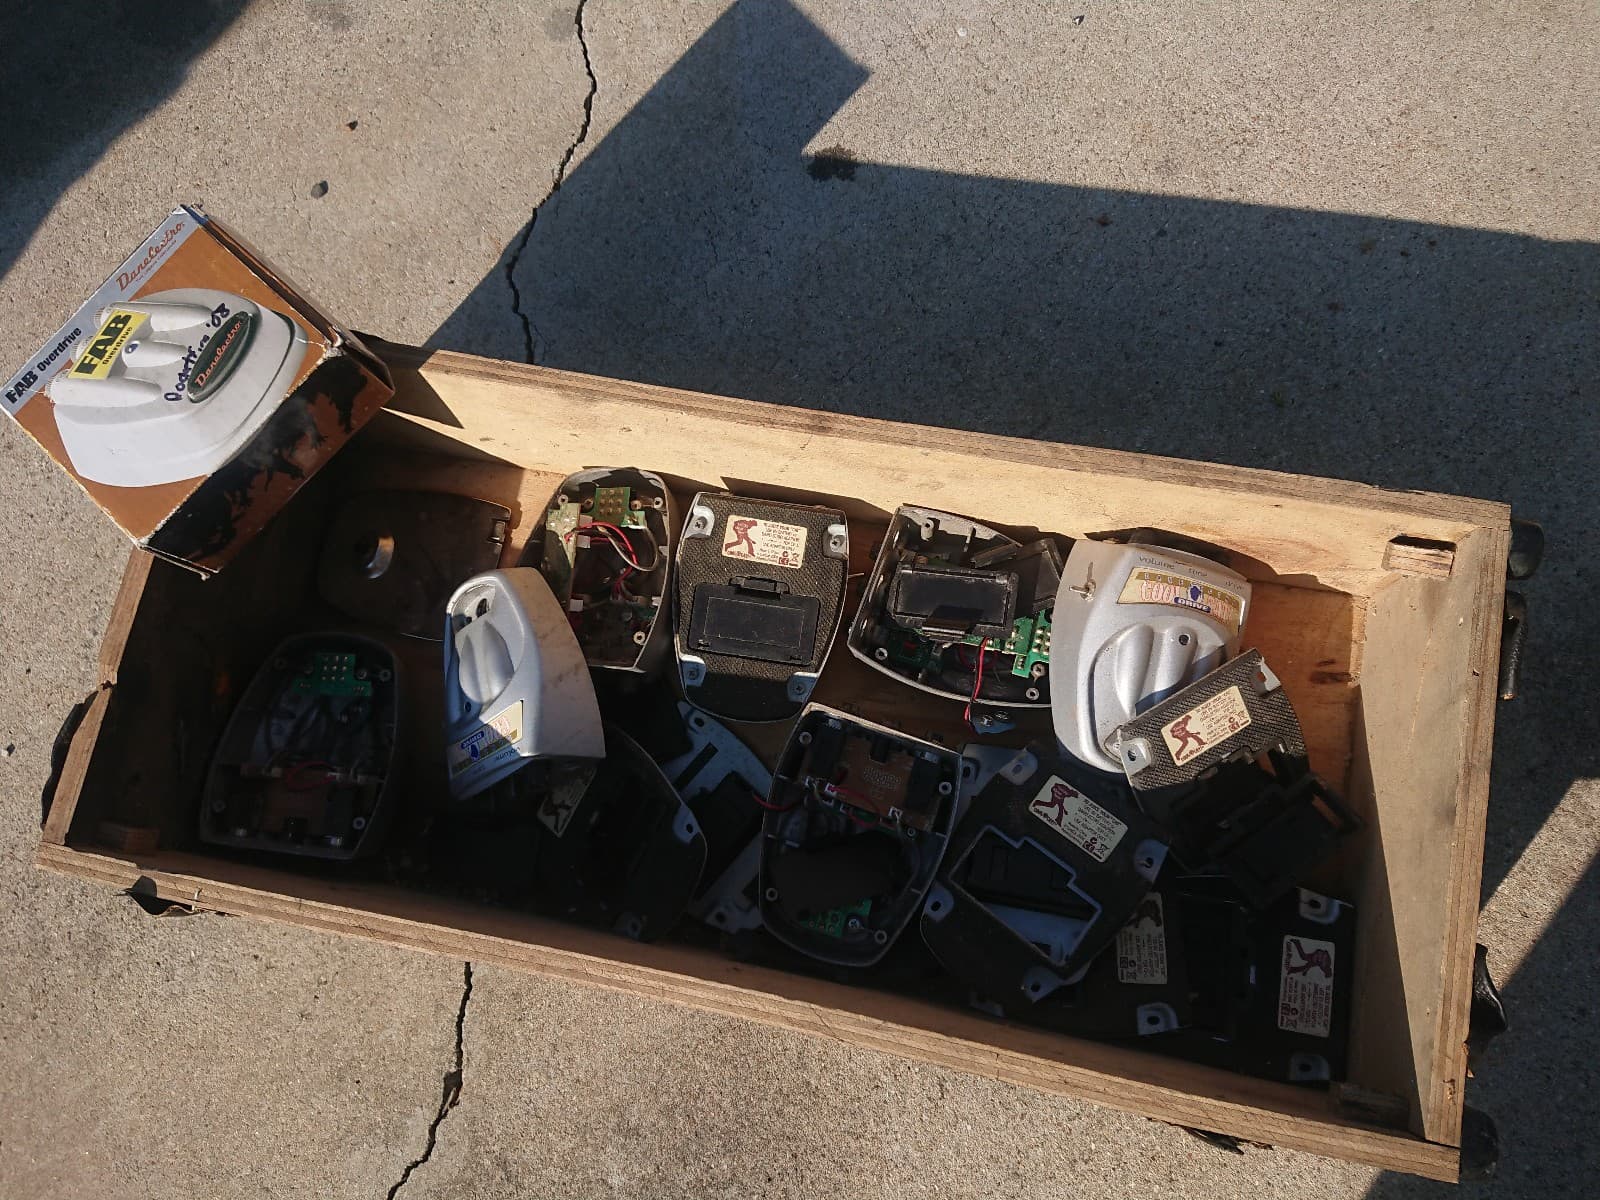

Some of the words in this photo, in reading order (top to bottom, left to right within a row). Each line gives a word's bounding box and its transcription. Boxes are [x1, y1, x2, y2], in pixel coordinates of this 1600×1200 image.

[5, 370, 39, 404] FAB
[36, 327, 82, 372] Overdrive
[74, 314, 132, 374] FAB
[102, 326, 133, 365] Overdrive
[194, 321, 241, 386] Danelectro
[1139, 556, 1175, 570] volume
